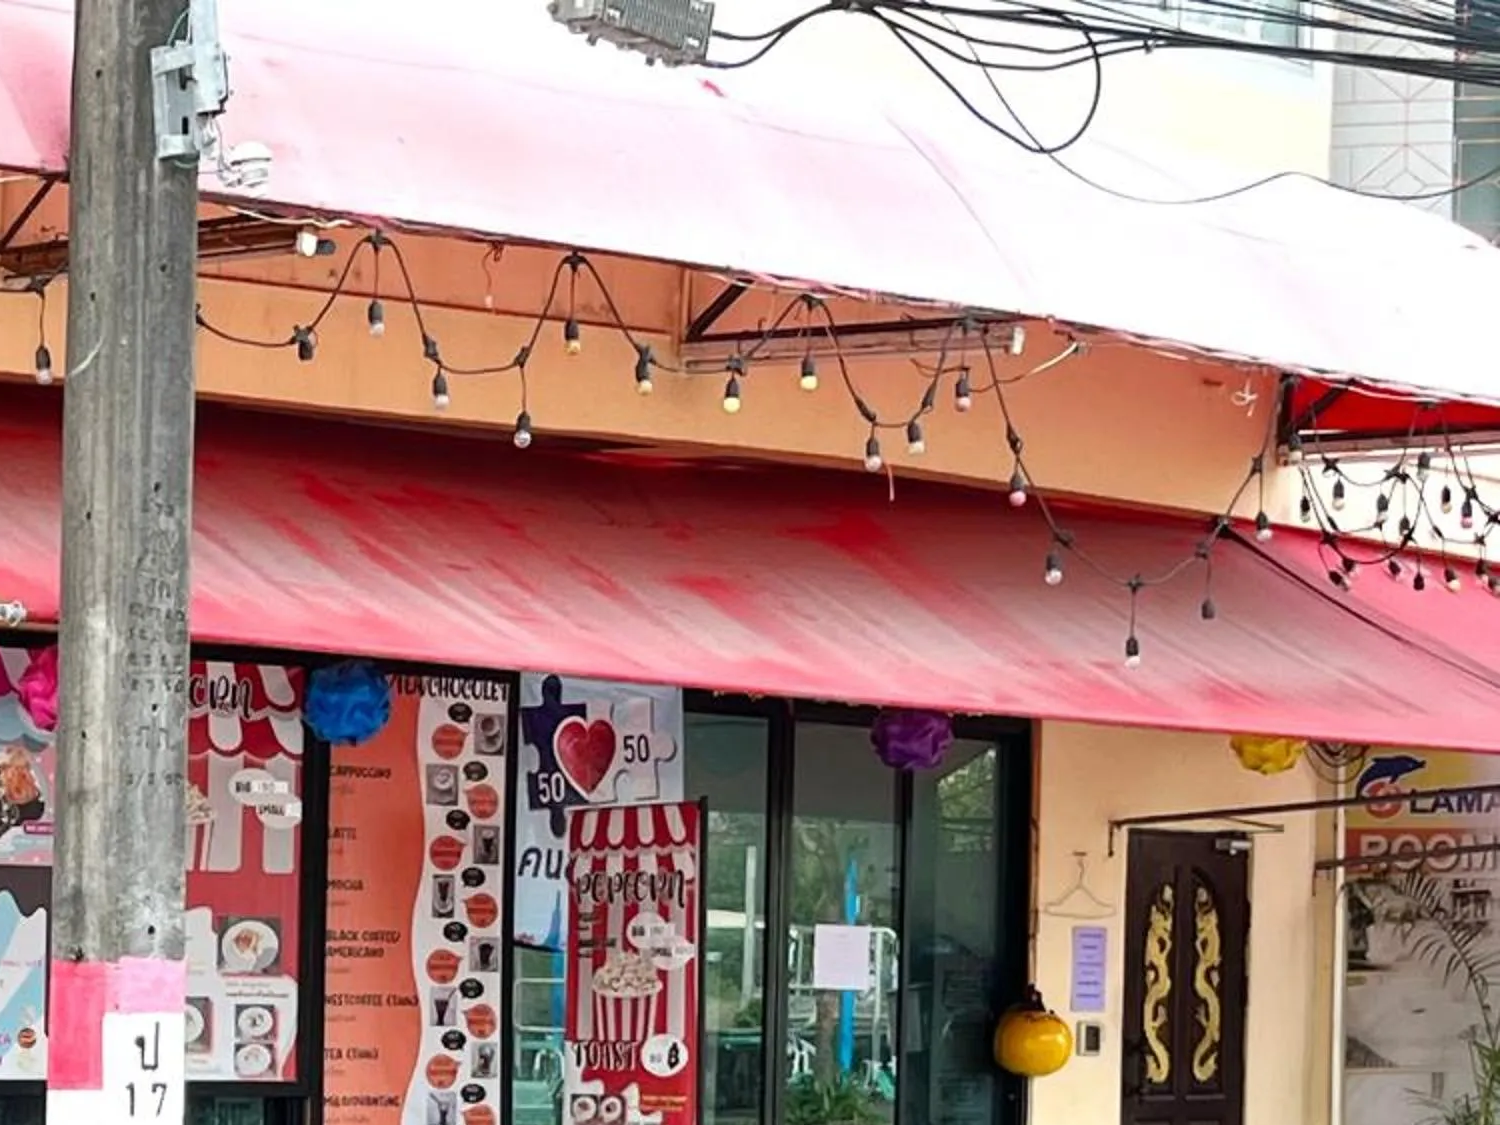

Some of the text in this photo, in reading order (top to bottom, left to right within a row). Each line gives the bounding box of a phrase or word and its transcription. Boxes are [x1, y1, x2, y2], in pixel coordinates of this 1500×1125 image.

[622, 733, 650, 764] 50
[537, 772, 566, 804] 50
[575, 1039, 640, 1072] TOAST
